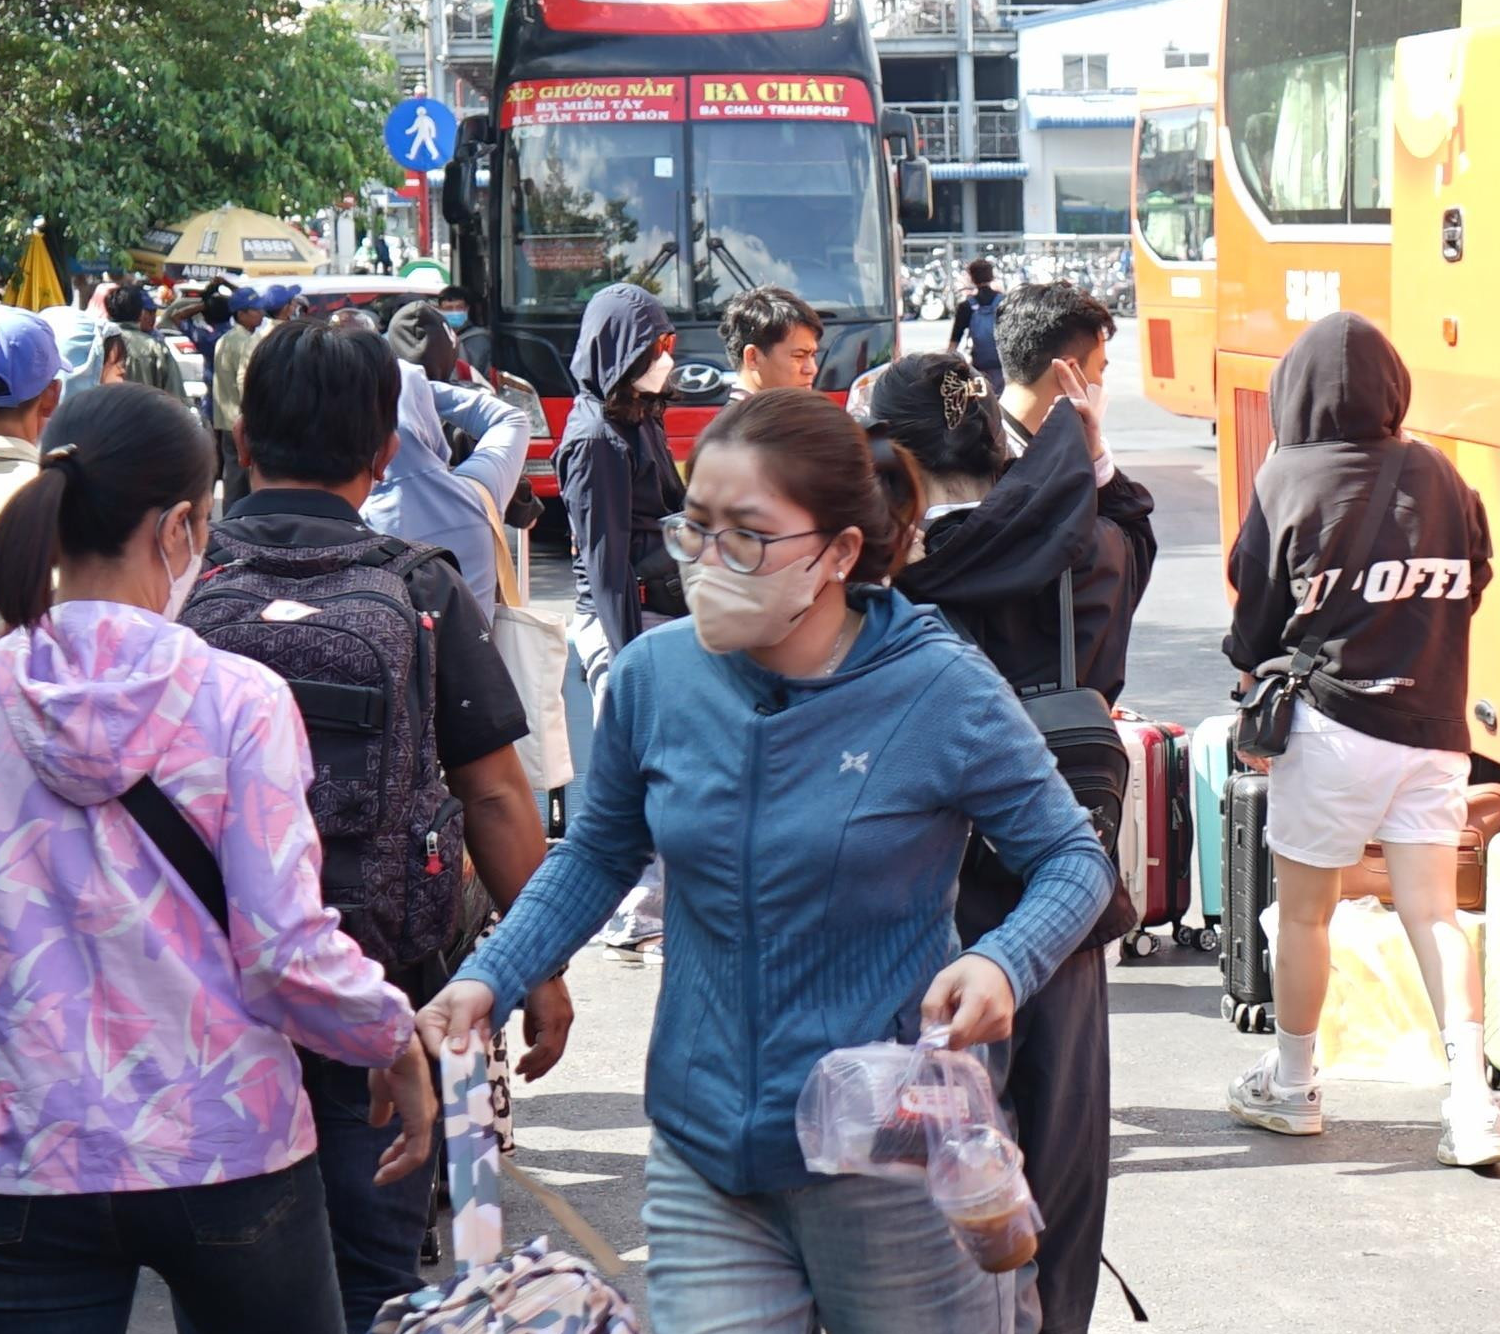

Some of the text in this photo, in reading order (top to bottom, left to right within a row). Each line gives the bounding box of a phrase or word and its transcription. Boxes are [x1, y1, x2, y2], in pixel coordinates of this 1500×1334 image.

[703, 77, 845, 103] BA CHÂU
[699, 104, 850, 117] BA CHAU TRANSPORT
